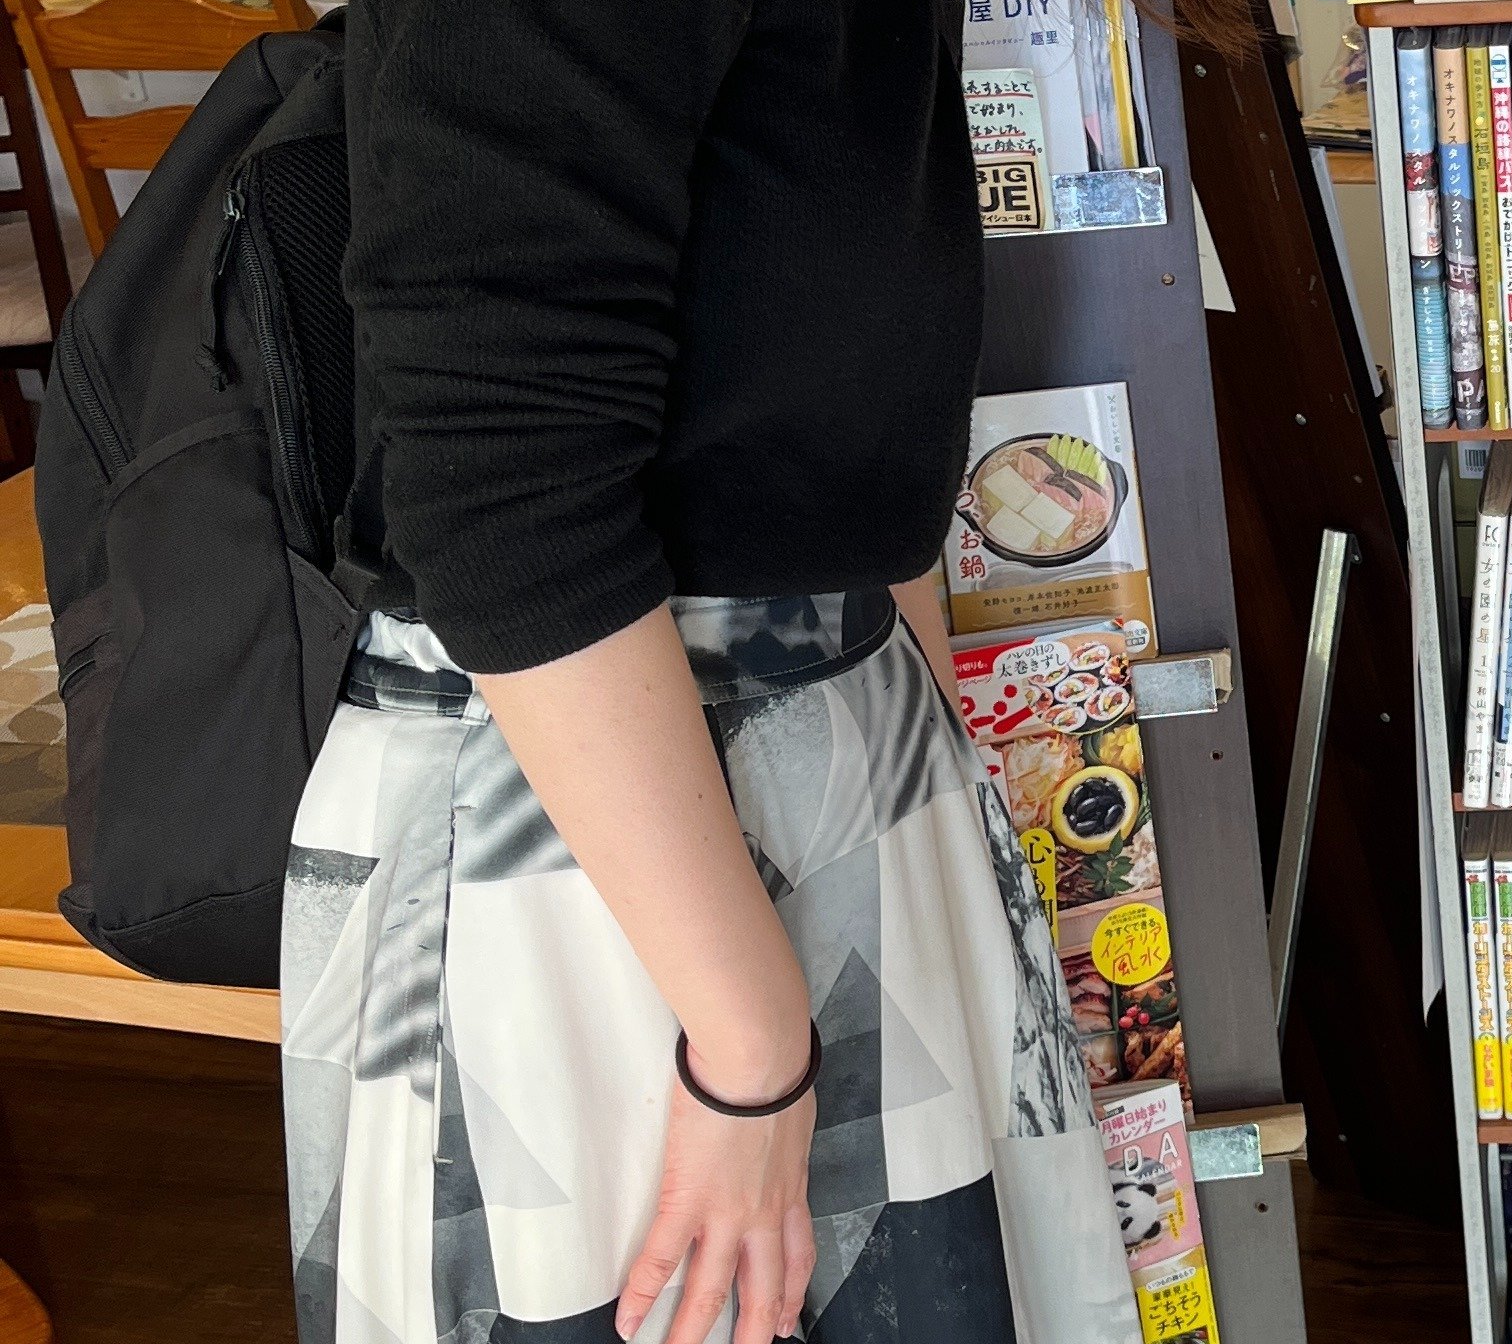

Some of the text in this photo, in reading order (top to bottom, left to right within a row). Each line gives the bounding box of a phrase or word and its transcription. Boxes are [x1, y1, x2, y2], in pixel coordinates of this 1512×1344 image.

[964, 80, 1032, 96] 売することで
[999, 653, 1067, 679] 太巻きずし
[1101, 922, 1162, 958] インテリア
[1113, 946, 1162, 981] 風水
[1102, 1099, 1166, 1135] 月曜日始まり
[1109, 1118, 1165, 1146] カレンダー
[1148, 1292, 1201, 1320] ごちそう
[1156, 1312, 1199, 1336] チキン
